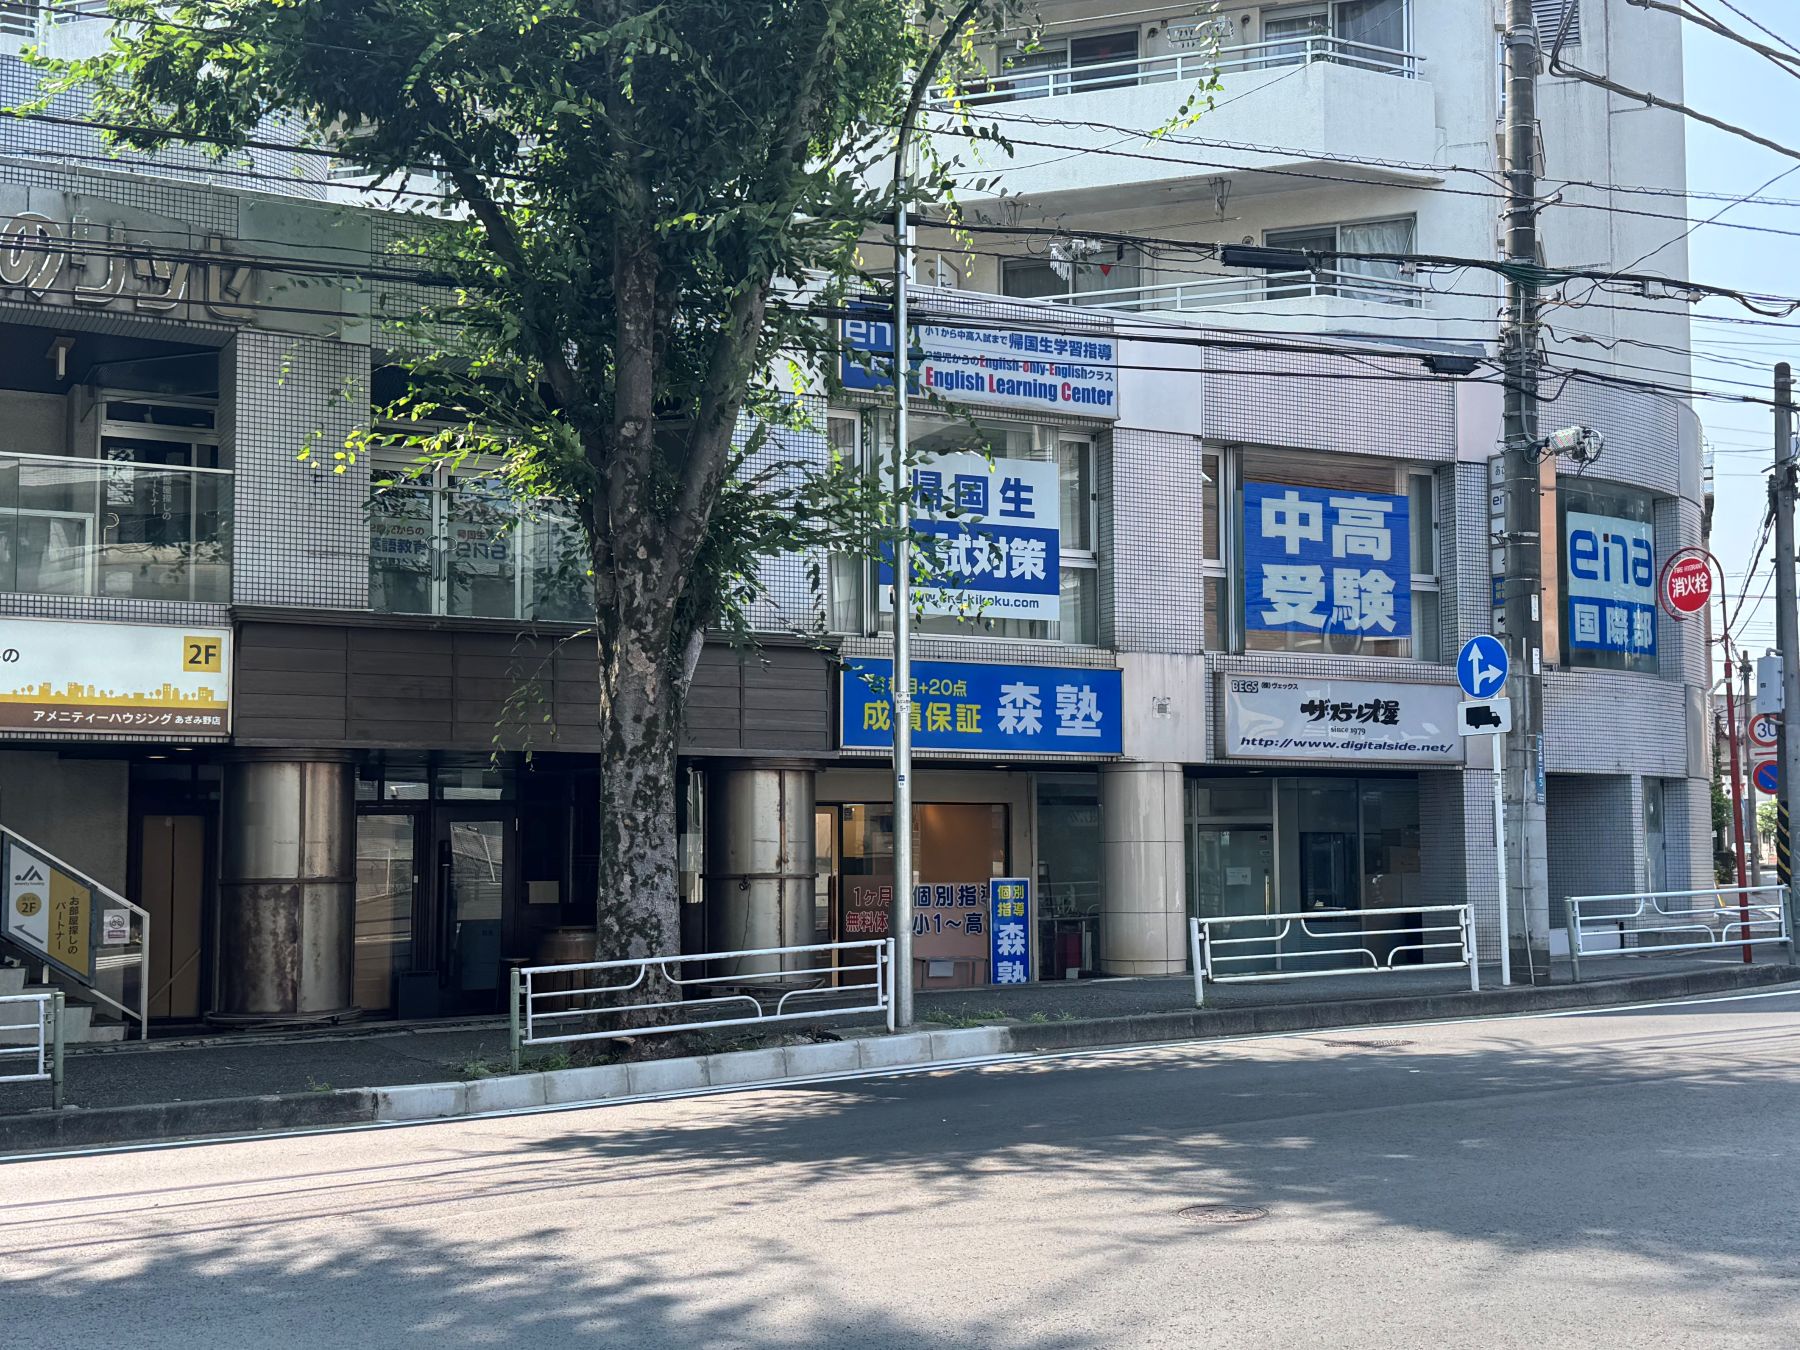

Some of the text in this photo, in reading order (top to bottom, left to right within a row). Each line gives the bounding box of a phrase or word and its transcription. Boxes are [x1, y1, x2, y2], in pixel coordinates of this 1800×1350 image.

[925, 327, 1112, 361] 小1から中高入試まで 帰国生学習指導
[926, 367, 1114, 406] English Learning Center
[909, 469, 1036, 519] 帰国生
[1261, 490, 1393, 561] 中高
[1261, 563, 1397, 633] 受験
[1672, 571, 1709, 598] 消火栓
[1574, 603, 1653, 649] 国際部
[0, 648, 20, 663] の
[188, 644, 217, 665] 2F
[33, 710, 221, 726] アメニティーハウジング あざみ野店
[998, 681, 1103, 737] 森塾
[1331, 726, 1366, 735] since 1979
[1240, 737, 1454, 753] http://www.digitalside.net/
[997, 884, 1025, 899] 個別
[22, 902, 36, 913] 2F
[997, 902, 1025, 917] 指導
[55, 902, 66, 950] パートナー
[68, 896, 79, 954] お部屋探しの
[912, 912, 987, 935] 小1〜高
